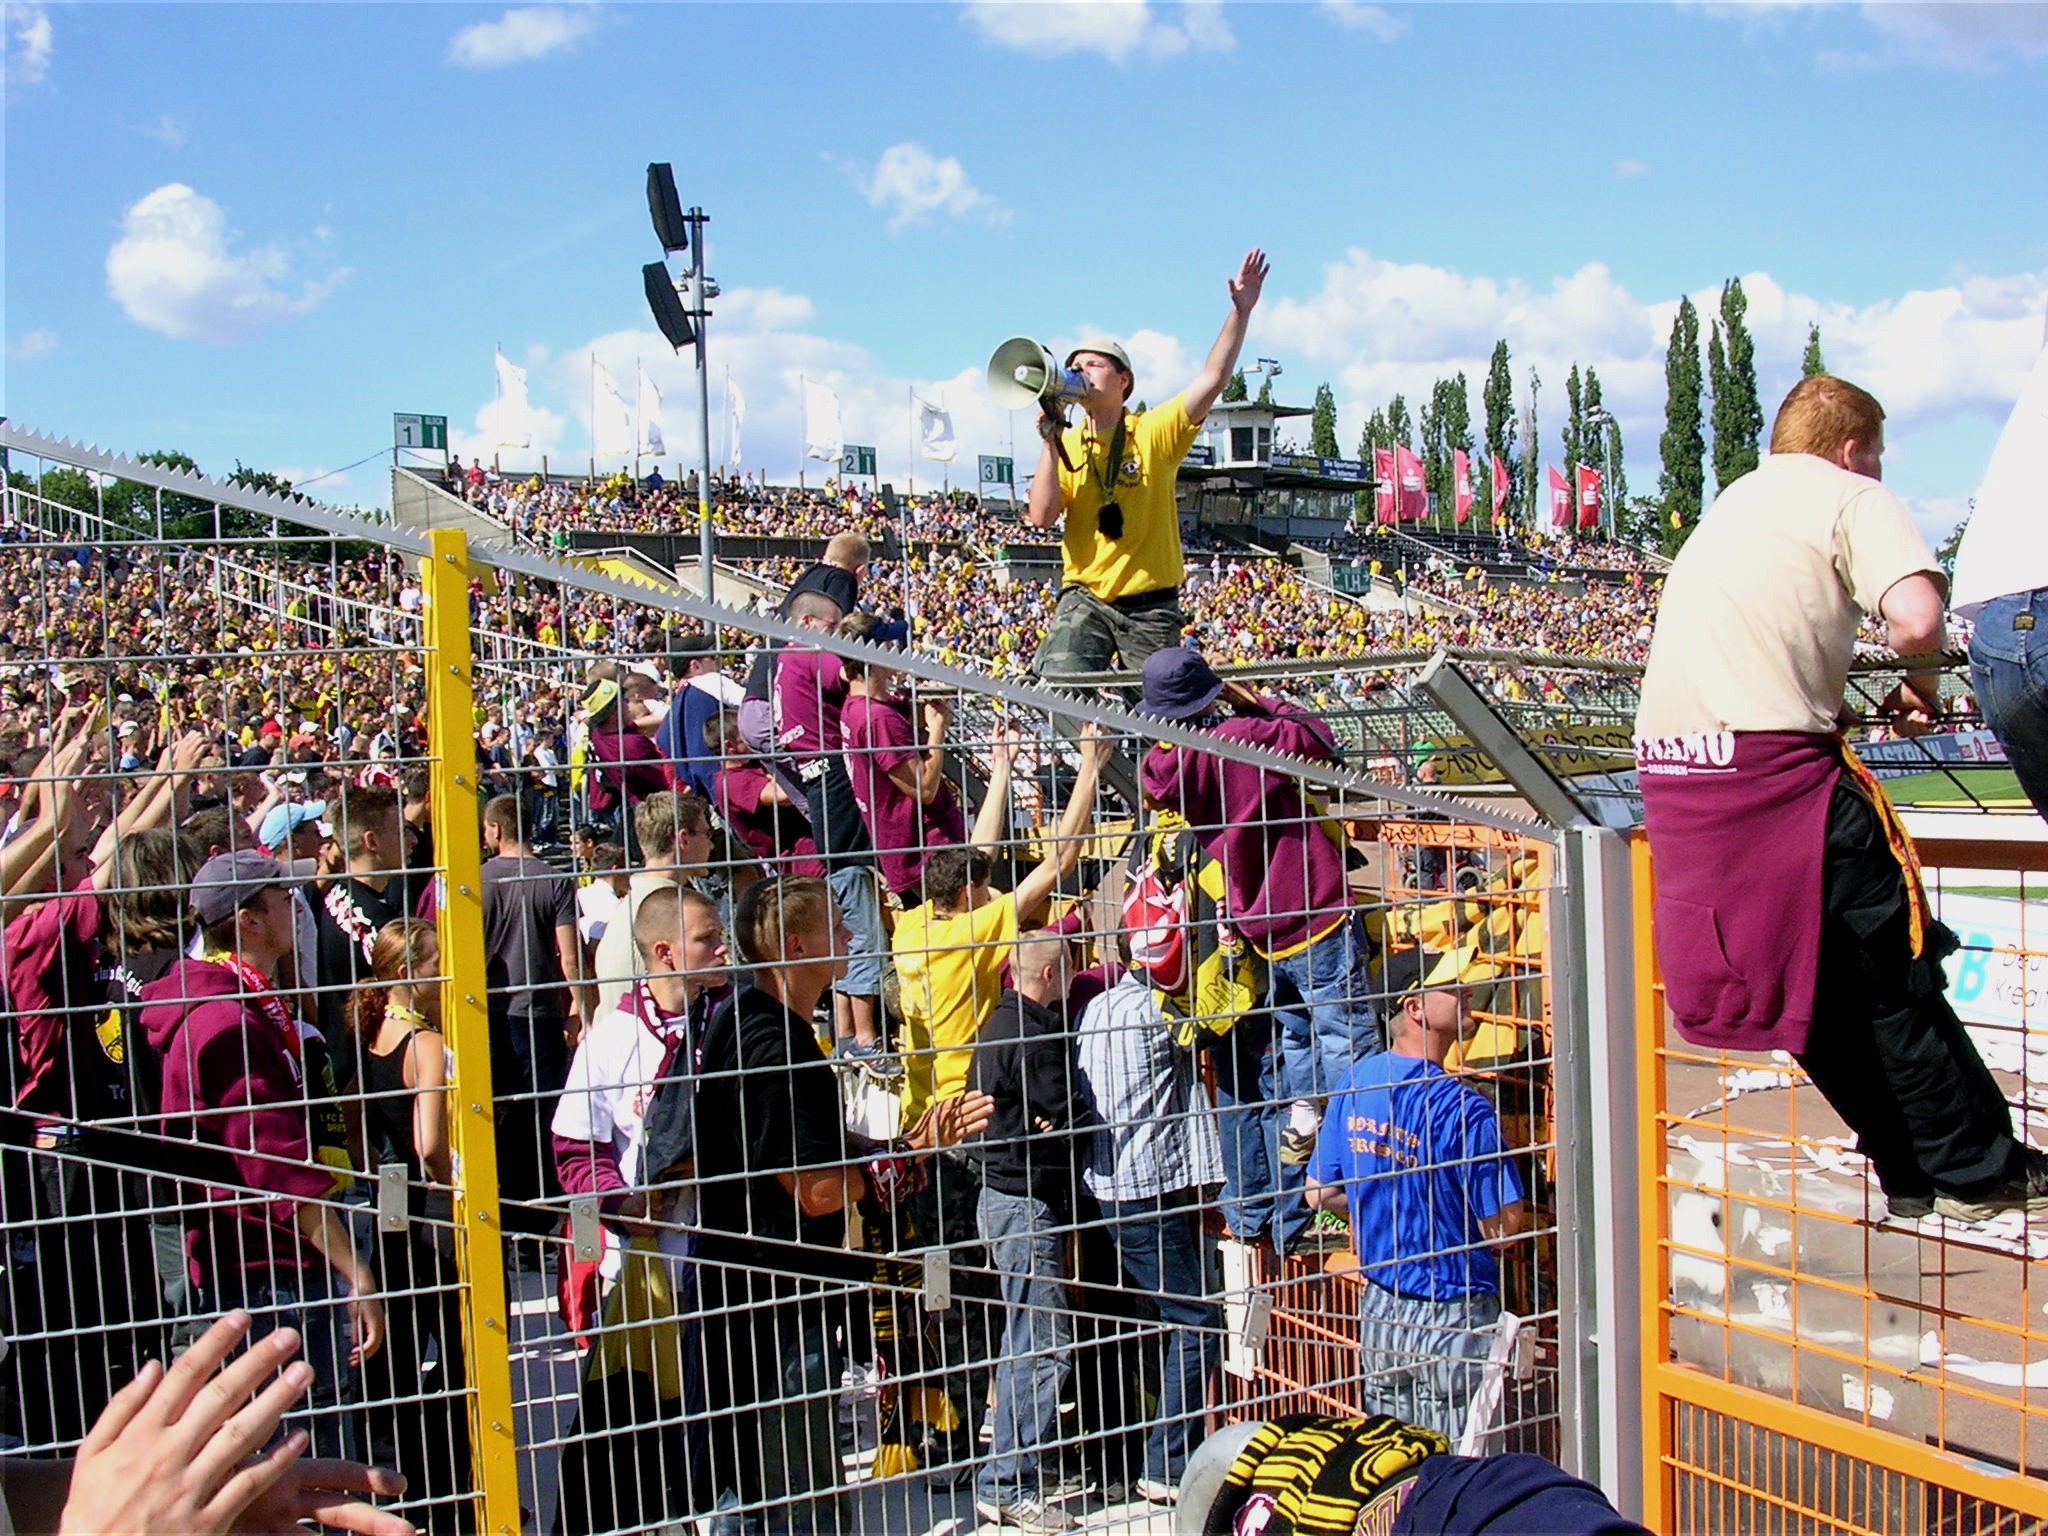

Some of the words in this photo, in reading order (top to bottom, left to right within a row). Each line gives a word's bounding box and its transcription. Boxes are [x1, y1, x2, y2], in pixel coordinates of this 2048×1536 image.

[403, 426, 411, 445] 1
[845, 455, 854, 471] 2
[985, 464, 993, 480] 3
[1946, 929, 1994, 1003] B
